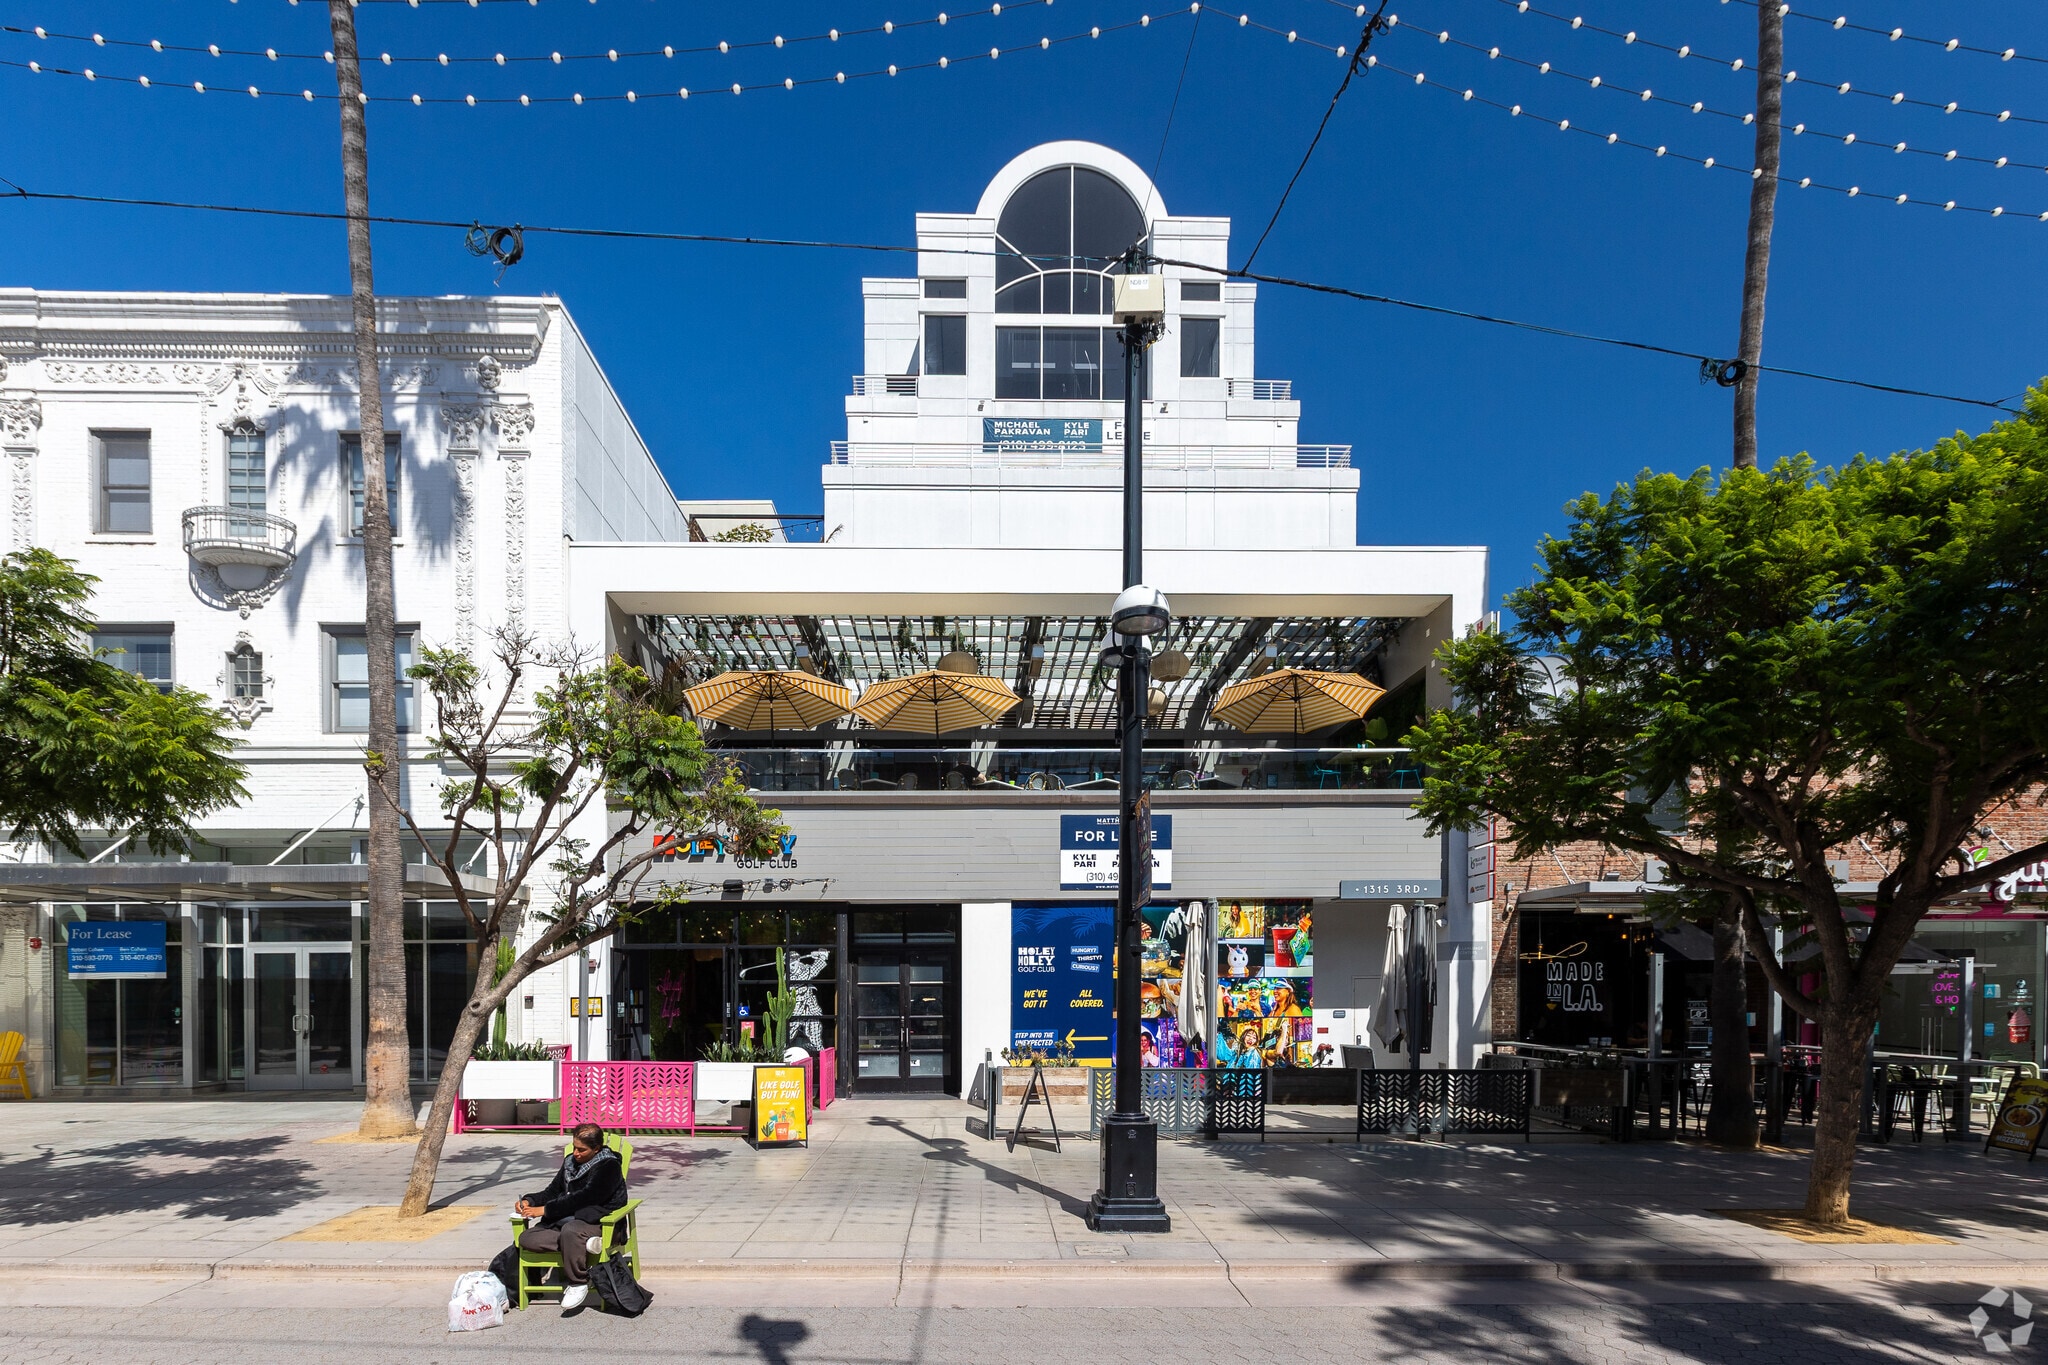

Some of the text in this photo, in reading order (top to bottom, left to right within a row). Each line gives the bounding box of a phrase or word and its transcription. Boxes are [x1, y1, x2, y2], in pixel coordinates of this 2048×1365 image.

[994, 428, 1051, 436] PAKRAVAN
[1106, 432, 1151, 440] LEE
[1075, 830, 1105, 842] FOR
[736, 859, 798, 869] GOLF CLUB
[1086, 872, 1106, 883] (310)
[1363, 884, 1420, 894] 1315 3RD
[72, 928, 133, 940] For Lease
[1018, 946, 1056, 956] HOLEY
[1072, 963, 1099, 971] CURIOUS?
[1546, 961, 1604, 981] MADE
[1023, 988, 1049, 998] WE'VE
[1078, 989, 1093, 998] ALL
[1546, 983, 1604, 1011] IN L.A.
[1023, 1000, 1049, 1008] GOT IT
[1069, 999, 1104, 1008] COVERED.
[1935, 995, 1960, 1004] & HO
[1014, 1039, 1054, 1047] UNEXPECTED
[760, 1081, 778, 1089] LIKE
[761, 1090, 778, 1099] BUT
